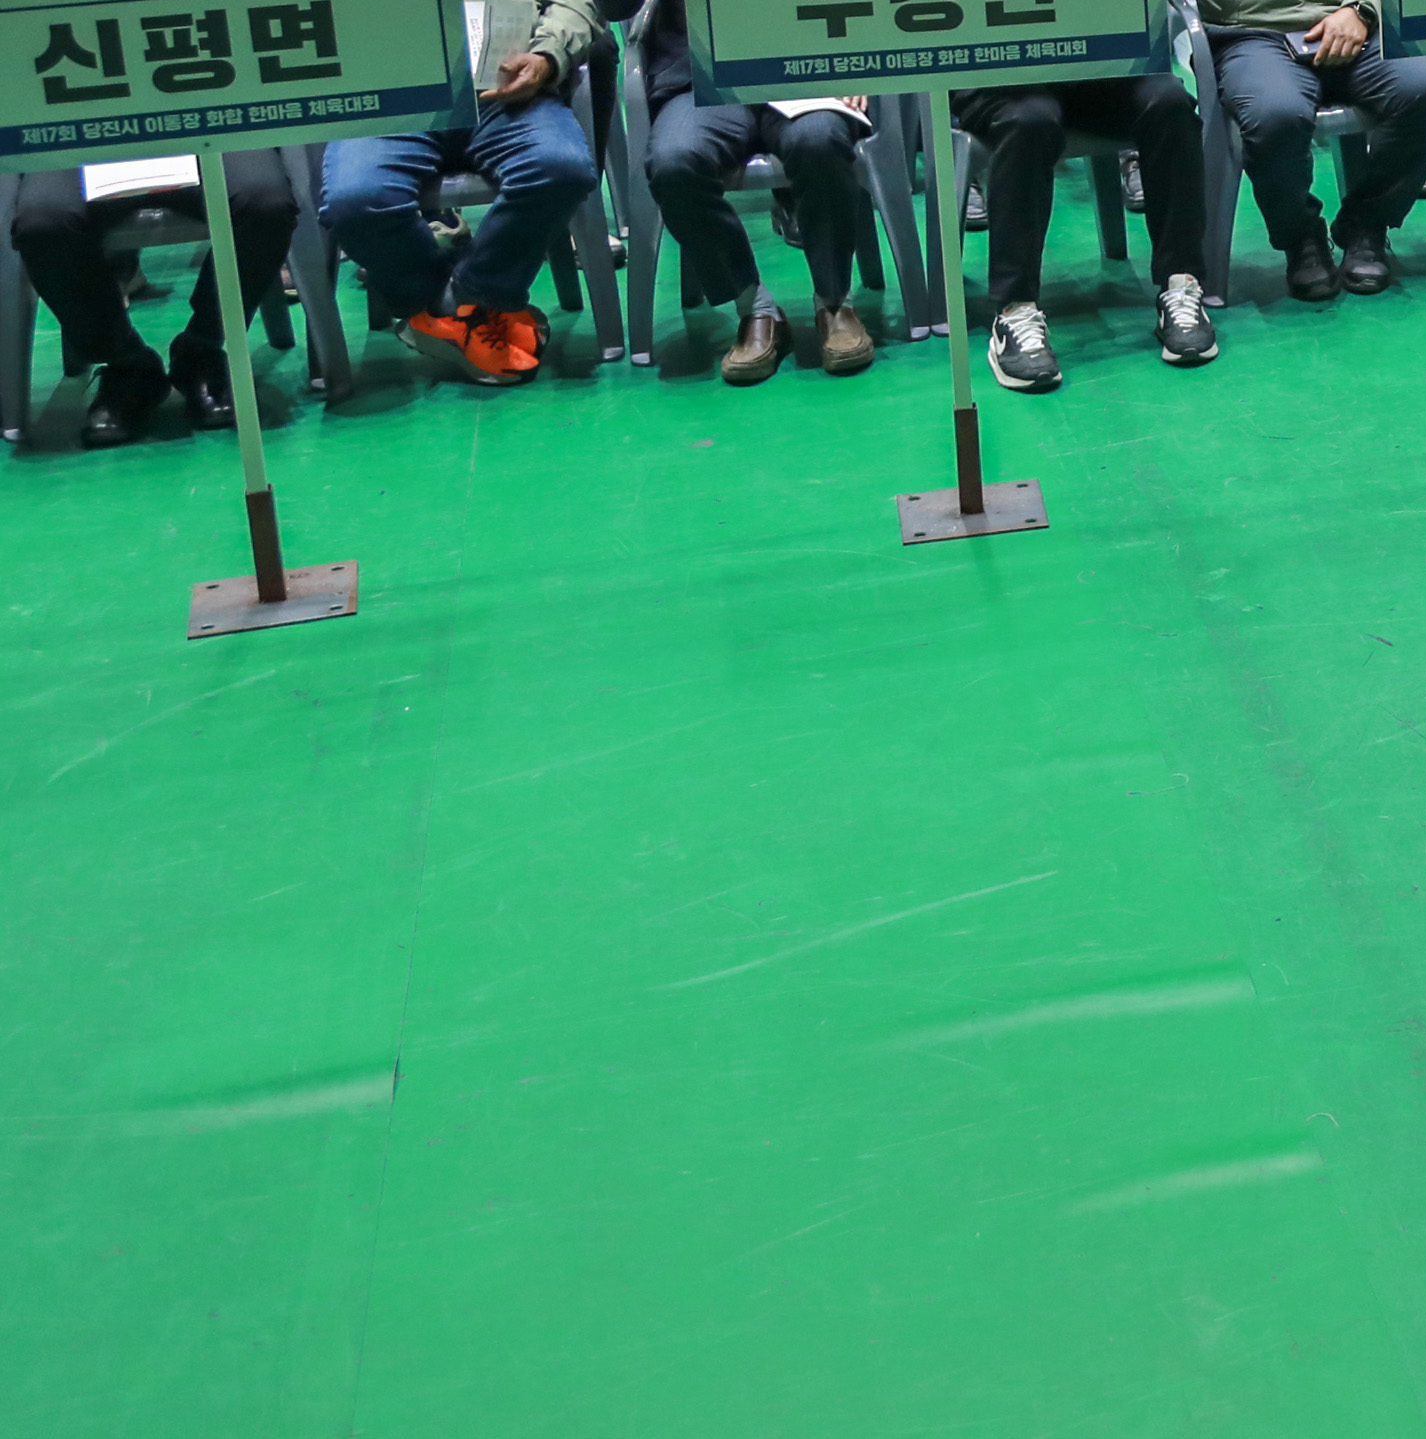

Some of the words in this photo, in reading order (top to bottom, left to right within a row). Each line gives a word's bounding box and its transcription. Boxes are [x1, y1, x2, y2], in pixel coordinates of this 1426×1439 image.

[34, 0, 342, 104] 신평면
[783, 56, 830, 75] 제17회
[833, 53, 882, 73] 당진시
[886, 50, 933, 70] 이통장
[938, 47, 970, 66] 화합
[974, 44, 1020, 63] 한마음
[1025, 39, 1087, 59] 체육대회
[22, 124, 77, 144] 제17회
[82, 117, 140, 140] 당진시
[145, 112, 200, 135] 이통장
[206, 107, 243, 129] 화합
[249, 101, 303, 123] 한마음
[308, 93, 380, 118] 체육대회
